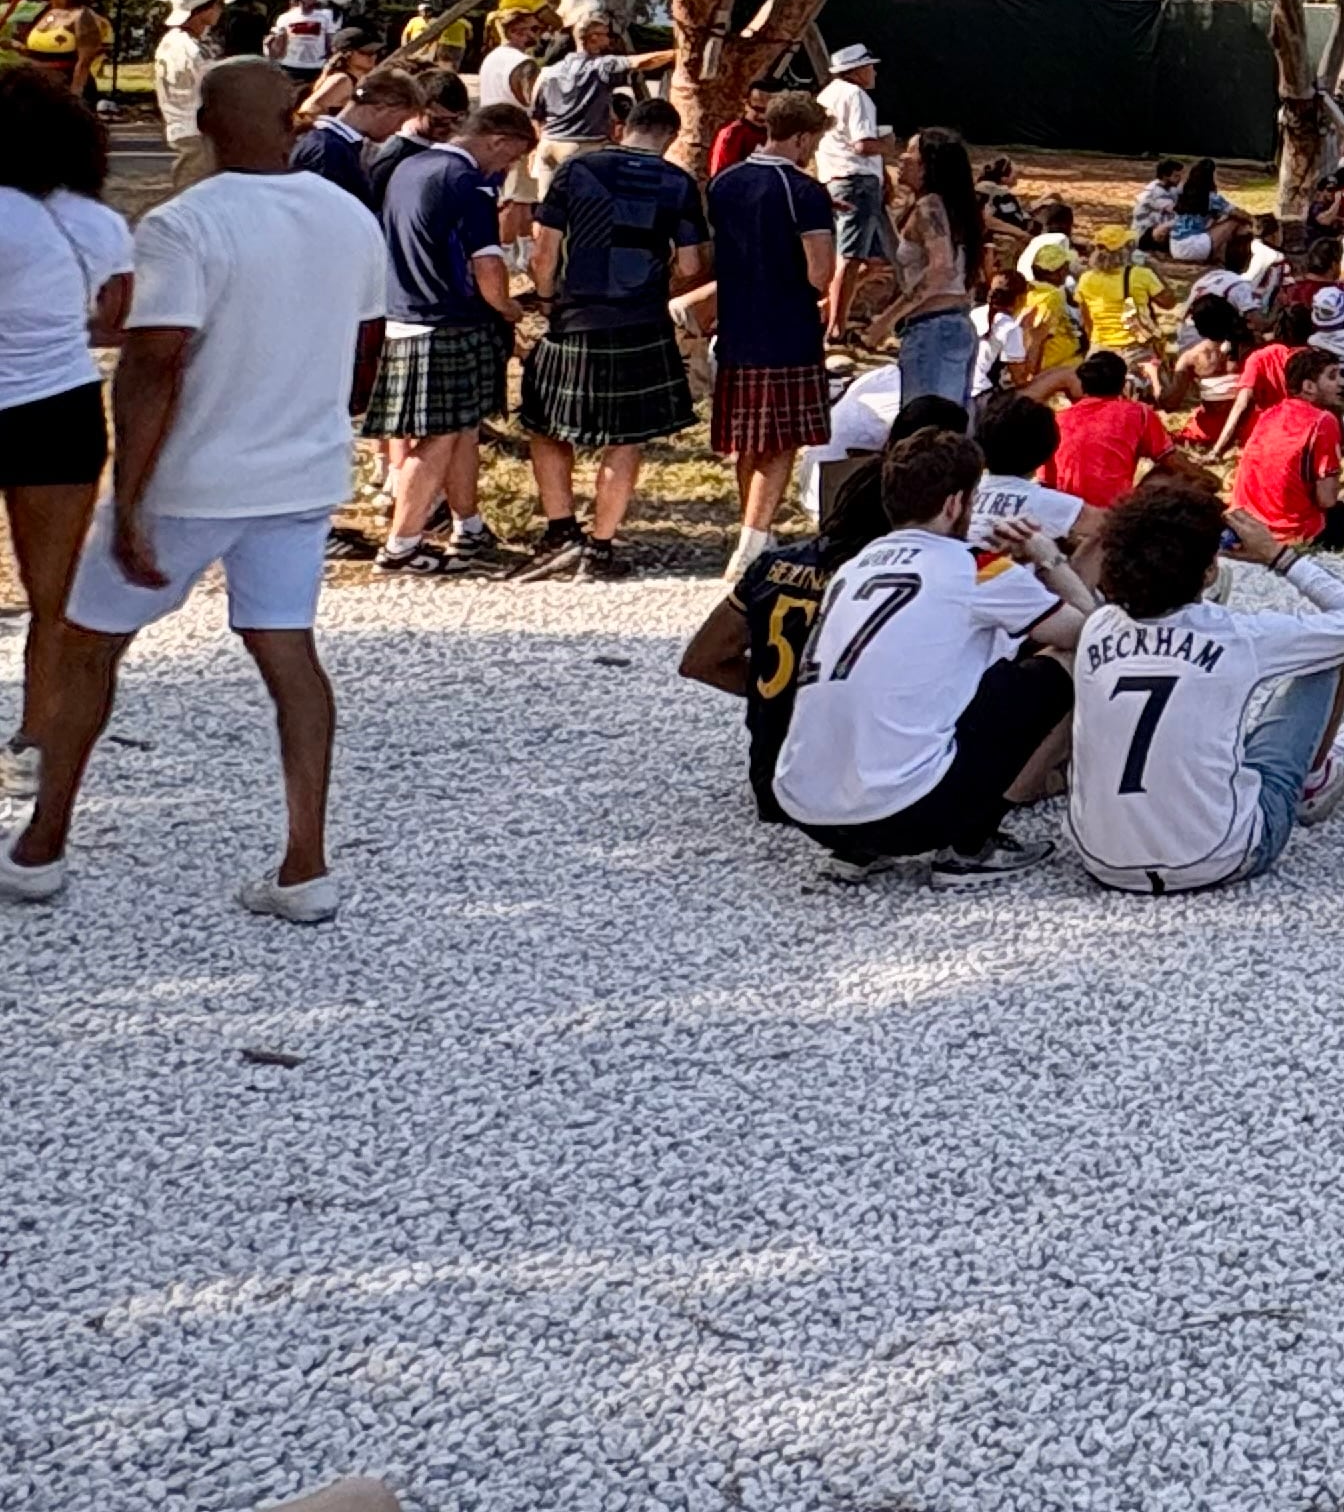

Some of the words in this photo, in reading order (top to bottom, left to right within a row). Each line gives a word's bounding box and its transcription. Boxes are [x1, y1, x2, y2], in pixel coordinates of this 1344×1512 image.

[756, 593, 819, 699] 5
[797, 573, 922, 684] 17
[1086, 626, 1225, 675] BECKHAM
[1108, 675, 1182, 795] 7
